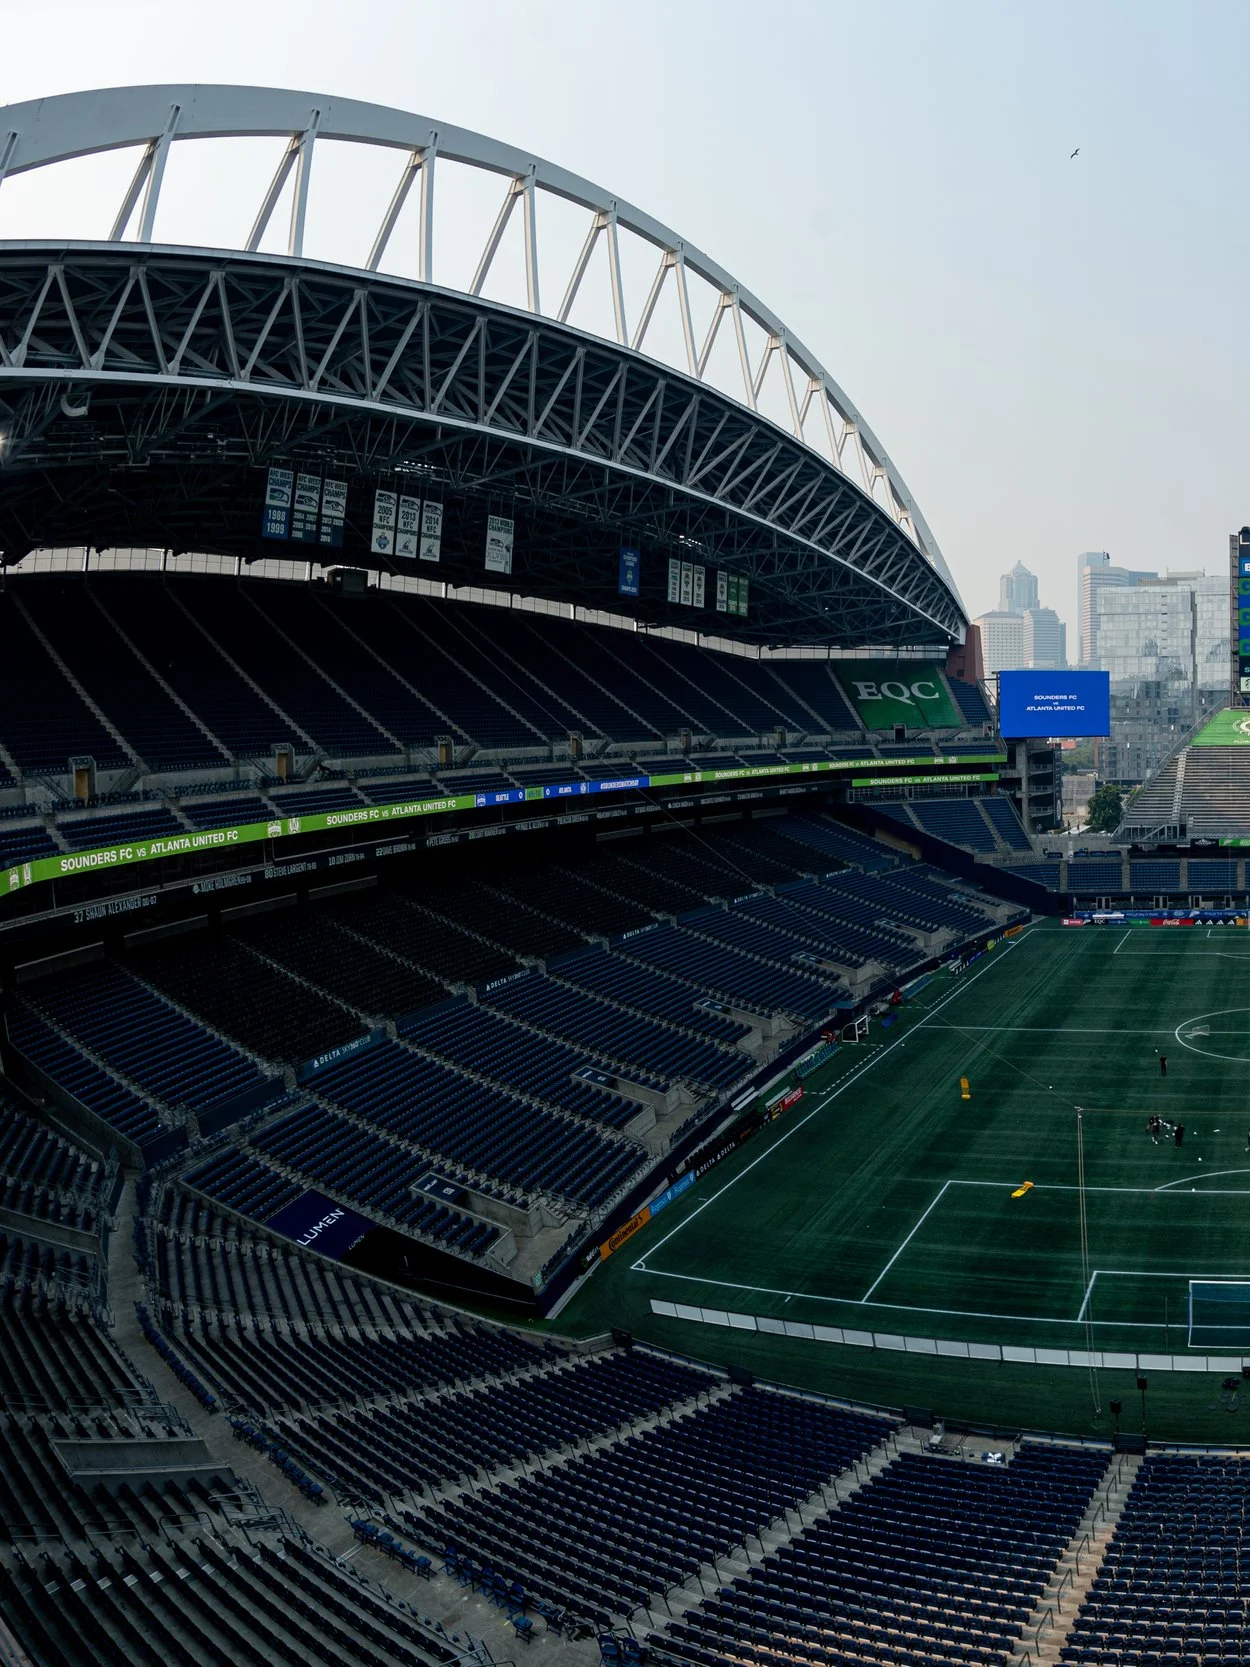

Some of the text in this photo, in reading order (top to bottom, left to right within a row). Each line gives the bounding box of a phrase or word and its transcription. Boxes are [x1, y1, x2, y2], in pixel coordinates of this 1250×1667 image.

[269, 478, 292, 488] CHAMPS
[297, 483, 319, 494] CHAMPS
[324, 488, 346, 500] CHAMPS
[268, 510, 286, 521] 1988
[378, 505, 392, 516] 2005
[402, 510, 416, 522] 2013
[379, 516, 390, 524] NFC
[403, 521, 414, 530] NFC
[425, 516, 439, 526] 2014
[267, 522, 285, 534] 1999
[426, 525, 436, 534] NFC
[488, 525, 512, 534] CHAMPIONS
[852, 682, 939, 705] EQC
[600, 779, 639, 789] #SOUNDERSMATCHDAY
[496, 793, 509, 802] SEATTLE
[327, 811, 368, 825] SOUNDERS
[370, 810, 379, 819] FC
[392, 804, 421, 815] ATLANTA
[422, 801, 446, 811] UNITED
[61, 830, 238, 872] SOUNDERS FC ATLANTA UNITED FC
[264, 862, 307, 879] 80 STEVE LARGENT
[215, 875, 240, 889] HOLMGREN
[74, 898, 141, 923] 37 SHAUN ALEXANDER
[491, 978, 507, 988] DELTA
[320, 1035, 371, 1064] DELTA CLUB
[721, 1142, 735, 1156] DELTA
[700, 1158, 715, 1173] DELTA
[297, 1208, 344, 1245] LUMEN
[608, 1218, 639, 1251] Continental
[348, 1234, 365, 1250] LUMEN
